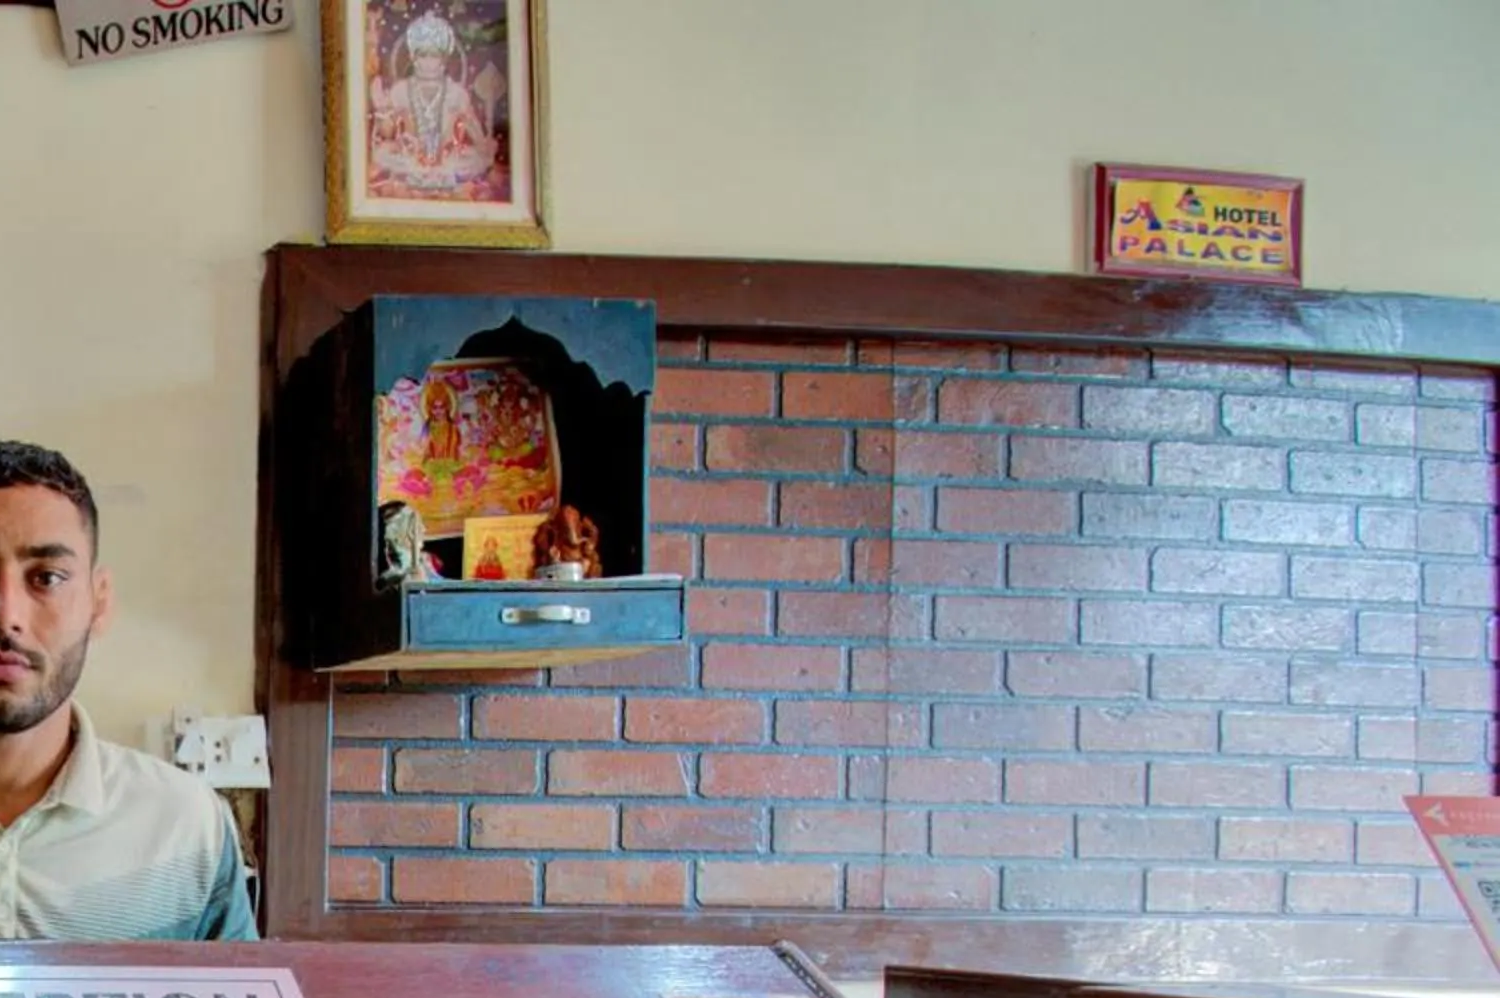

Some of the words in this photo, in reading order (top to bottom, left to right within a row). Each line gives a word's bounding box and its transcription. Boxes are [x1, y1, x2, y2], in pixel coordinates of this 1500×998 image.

[75, 22, 125, 59] NO
[131, 0, 284, 48] SMOKING
[1119, 199, 1284, 242] ASIAN
[1214, 205, 1282, 227] HOTEL
[1118, 235, 1284, 265] PALACE
